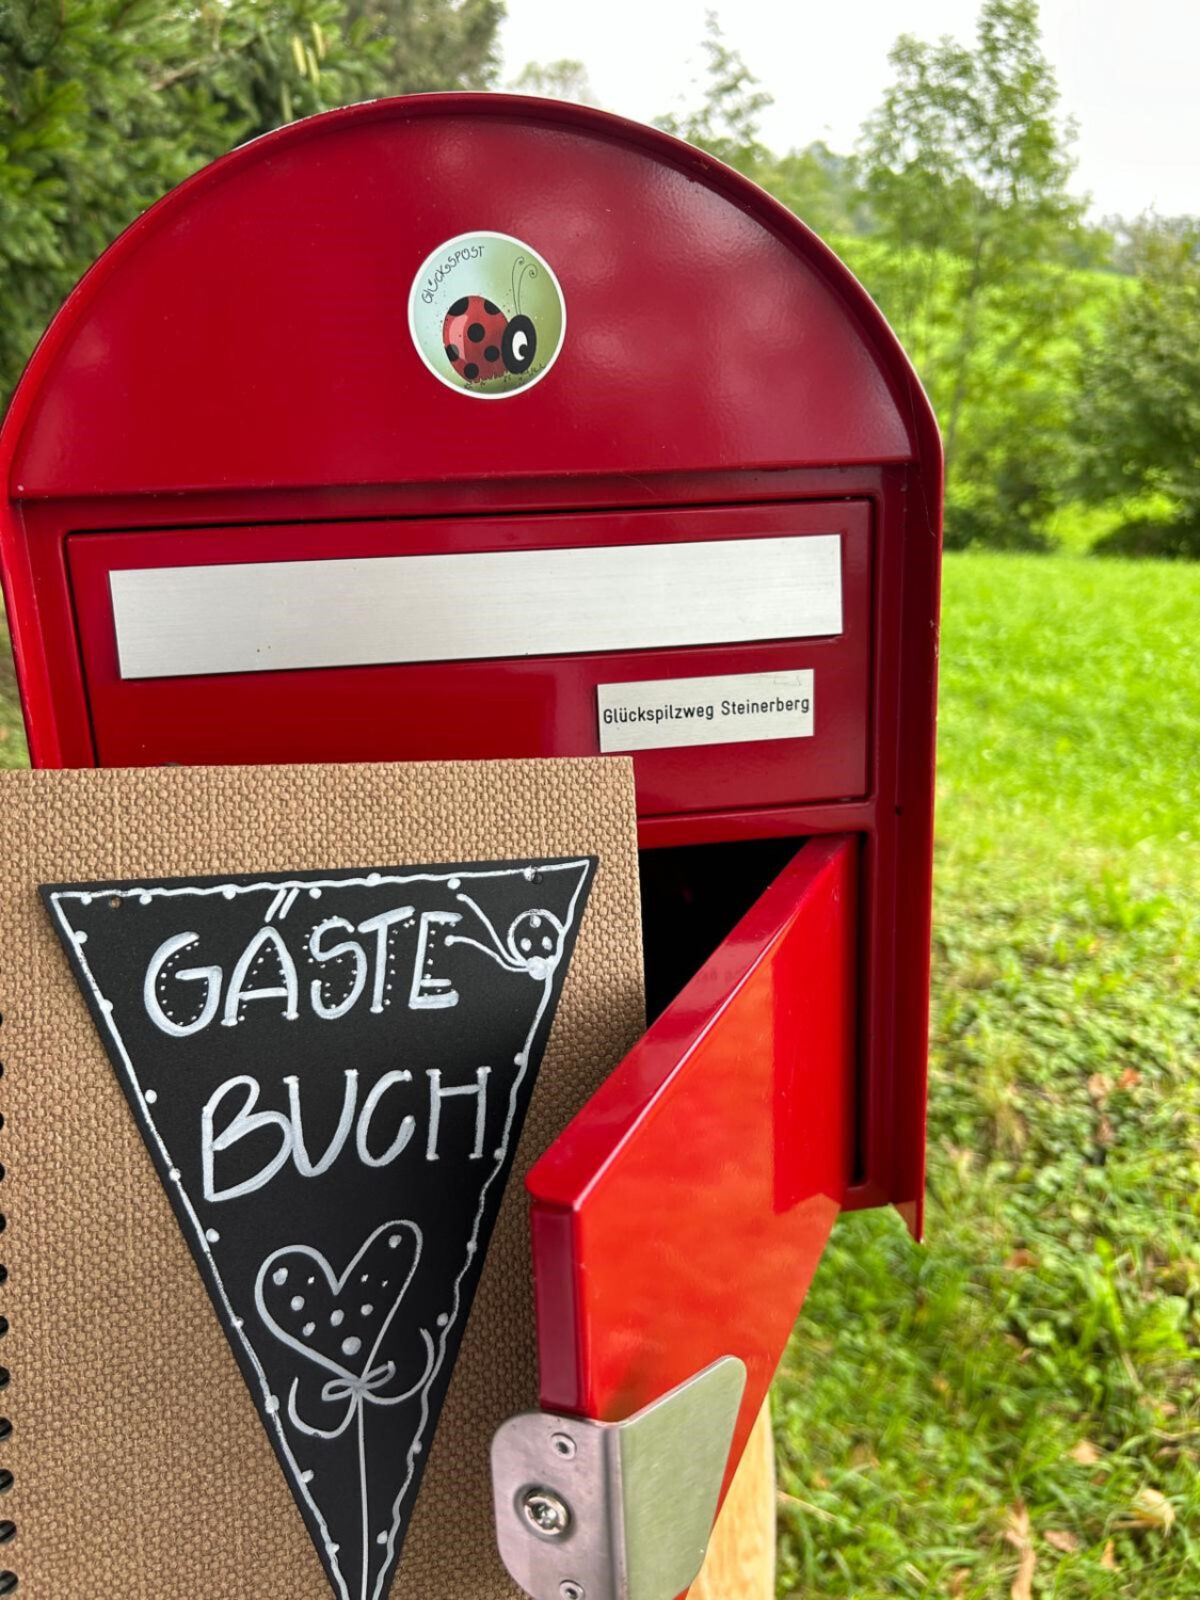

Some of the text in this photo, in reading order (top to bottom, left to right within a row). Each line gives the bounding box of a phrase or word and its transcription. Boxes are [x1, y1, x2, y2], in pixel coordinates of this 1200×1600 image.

[603, 697, 810, 724] Glückspilzweg Steinerberg
[144, 888, 463, 1037] GÄSTE
[202, 1066, 491, 1203] BUCH
